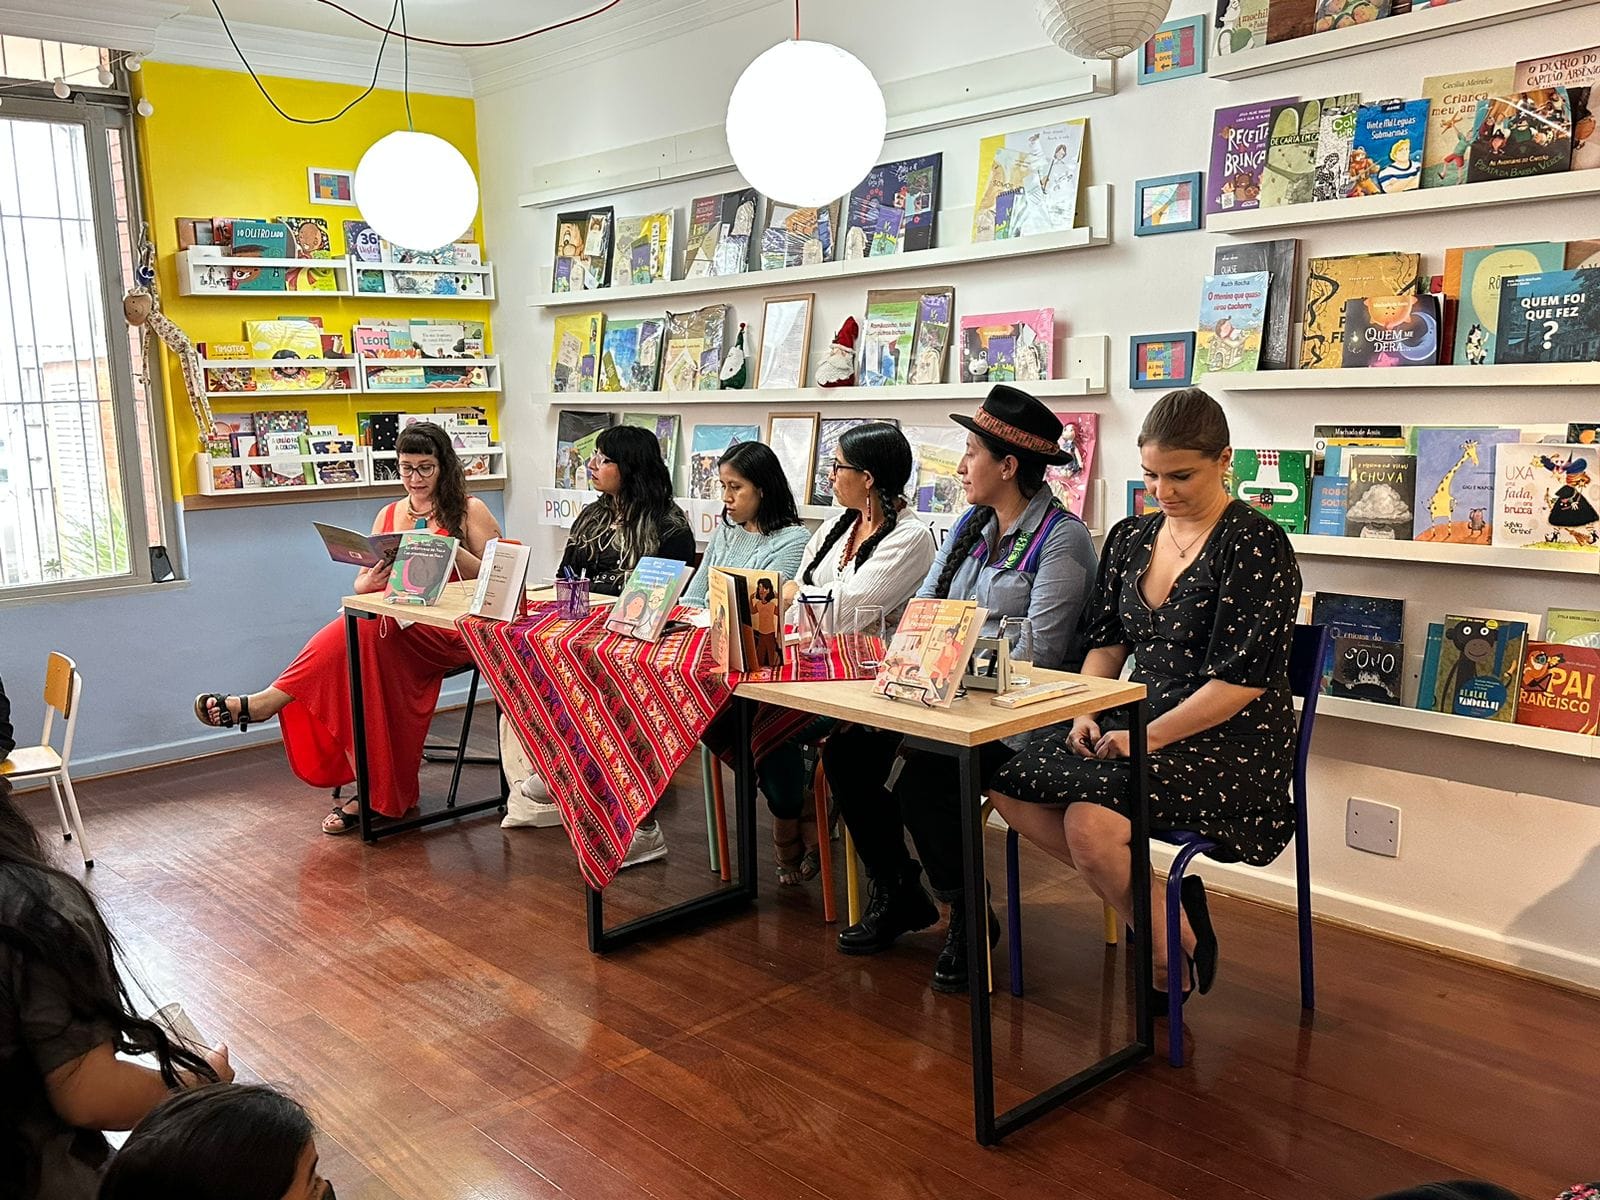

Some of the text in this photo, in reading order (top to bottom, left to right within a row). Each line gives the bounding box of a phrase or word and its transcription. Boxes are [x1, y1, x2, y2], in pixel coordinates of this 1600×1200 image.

[1528, 53, 1597, 74] O DIÁRIO DO
[1526, 71, 1563, 86] CAPITÃO
[1443, 91, 1489, 105] Criança
[1432, 105, 1455, 116] meu
[245, 228, 271, 239] OUTRO
[360, 232, 377, 245] 36
[1208, 291, 1213, 300] O
[1234, 292, 1245, 301] que
[1521, 293, 1586, 309] QUEM FOI
[1525, 306, 1579, 321] QUE FEZ
[1365, 327, 1402, 342] QUEM
[1542, 320, 1559, 350] ?
[1360, 471, 1403, 483] CHUVA
[1505, 466, 1535, 480] UXA
[1504, 487, 1533, 500] fada,
[1504, 504, 1533, 515] bruxa
[1344, 647, 1395, 673] SONO
[1547, 667, 1596, 700] PAI
